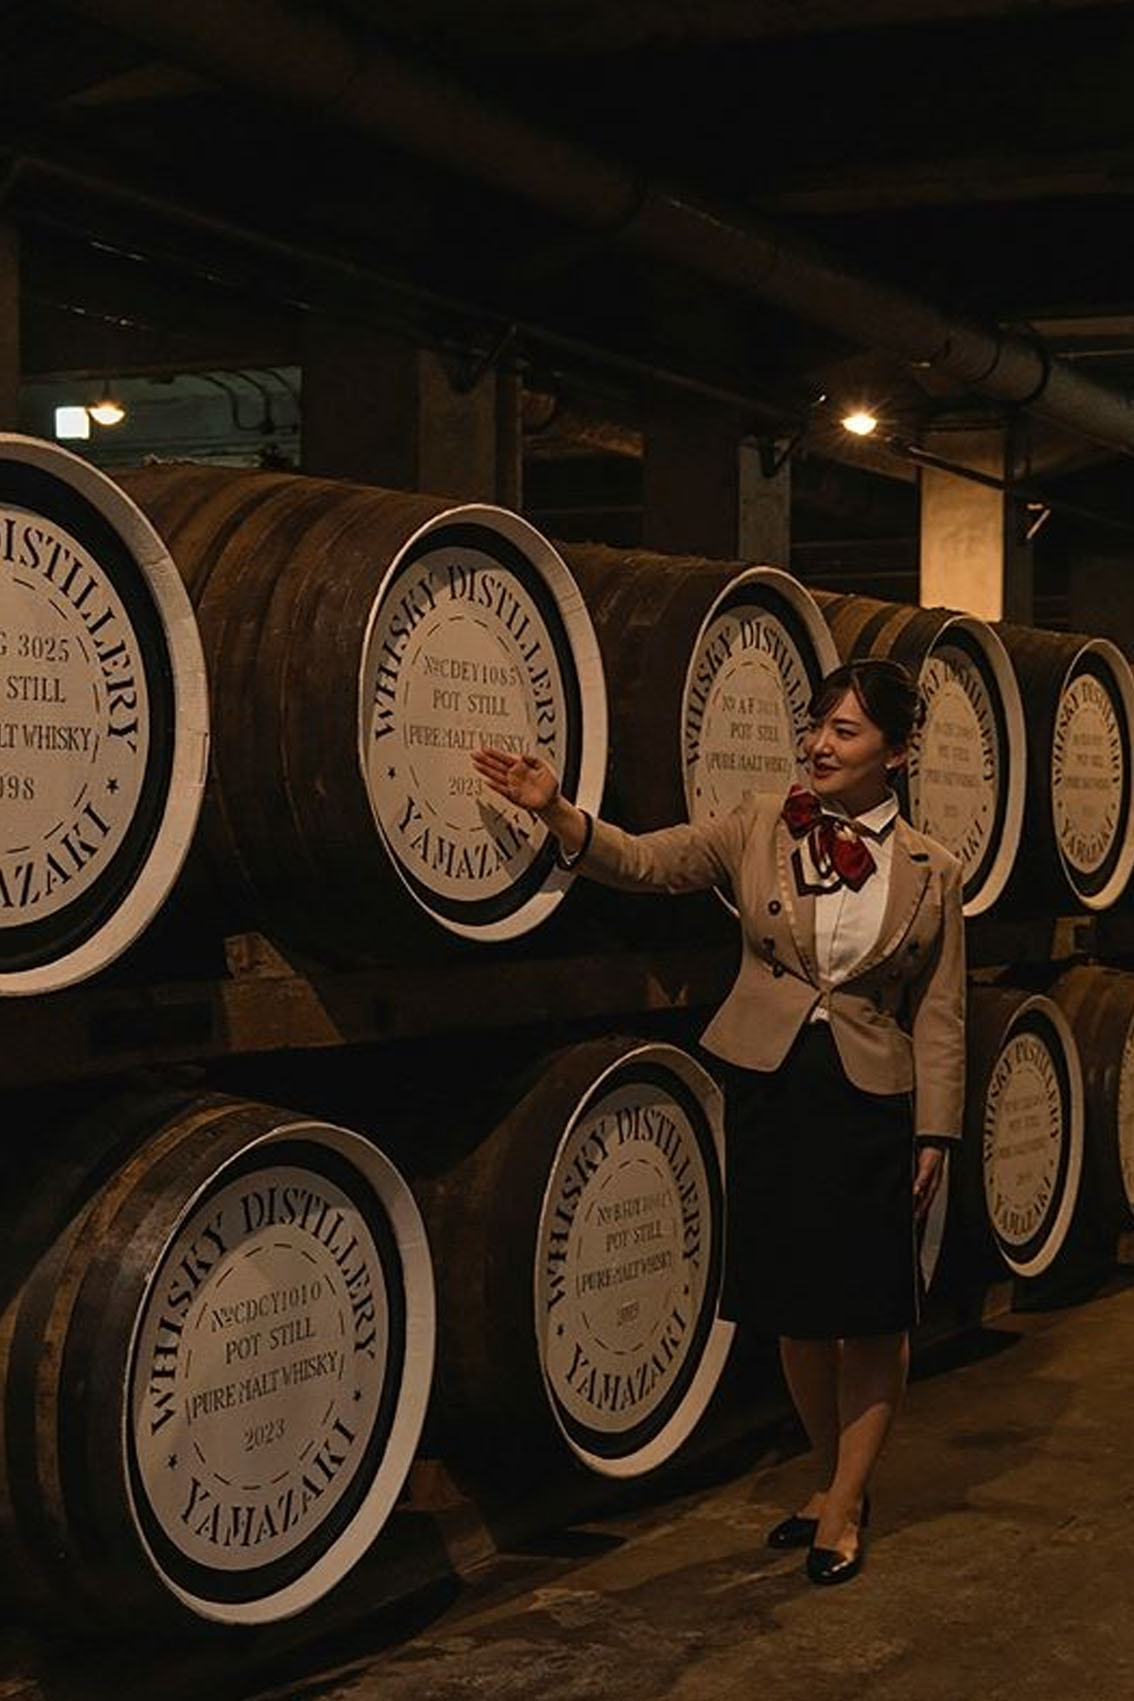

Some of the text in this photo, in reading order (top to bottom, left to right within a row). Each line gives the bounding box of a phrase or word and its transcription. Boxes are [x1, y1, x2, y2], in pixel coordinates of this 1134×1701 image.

[0, 518, 138, 754] ISTILLERY
[18, 633, 70, 662] 3025
[374, 564, 556, 758] WHISKY DISTILLERY
[7, 675, 66, 703] STILL
[432, 689, 509, 716] POT STILL
[685, 625, 733, 766] WHISKY
[22, 724, 92, 751] WHISKY
[0, 774, 34, 801] 98
[546, 1106, 700, 1313] WHISKY DISTILLERY
[151, 1187, 377, 1436] WHISKY DISTILLERY
[226, 1317, 317, 1365] POT STILL
[192, 1350, 338, 1419] PURE MALT WHISKY
[566, 1308, 686, 1412] YAMAZAKI
[244, 1417, 285, 1452] 2023
[181, 1418, 355, 1547] YAMAZAKI
